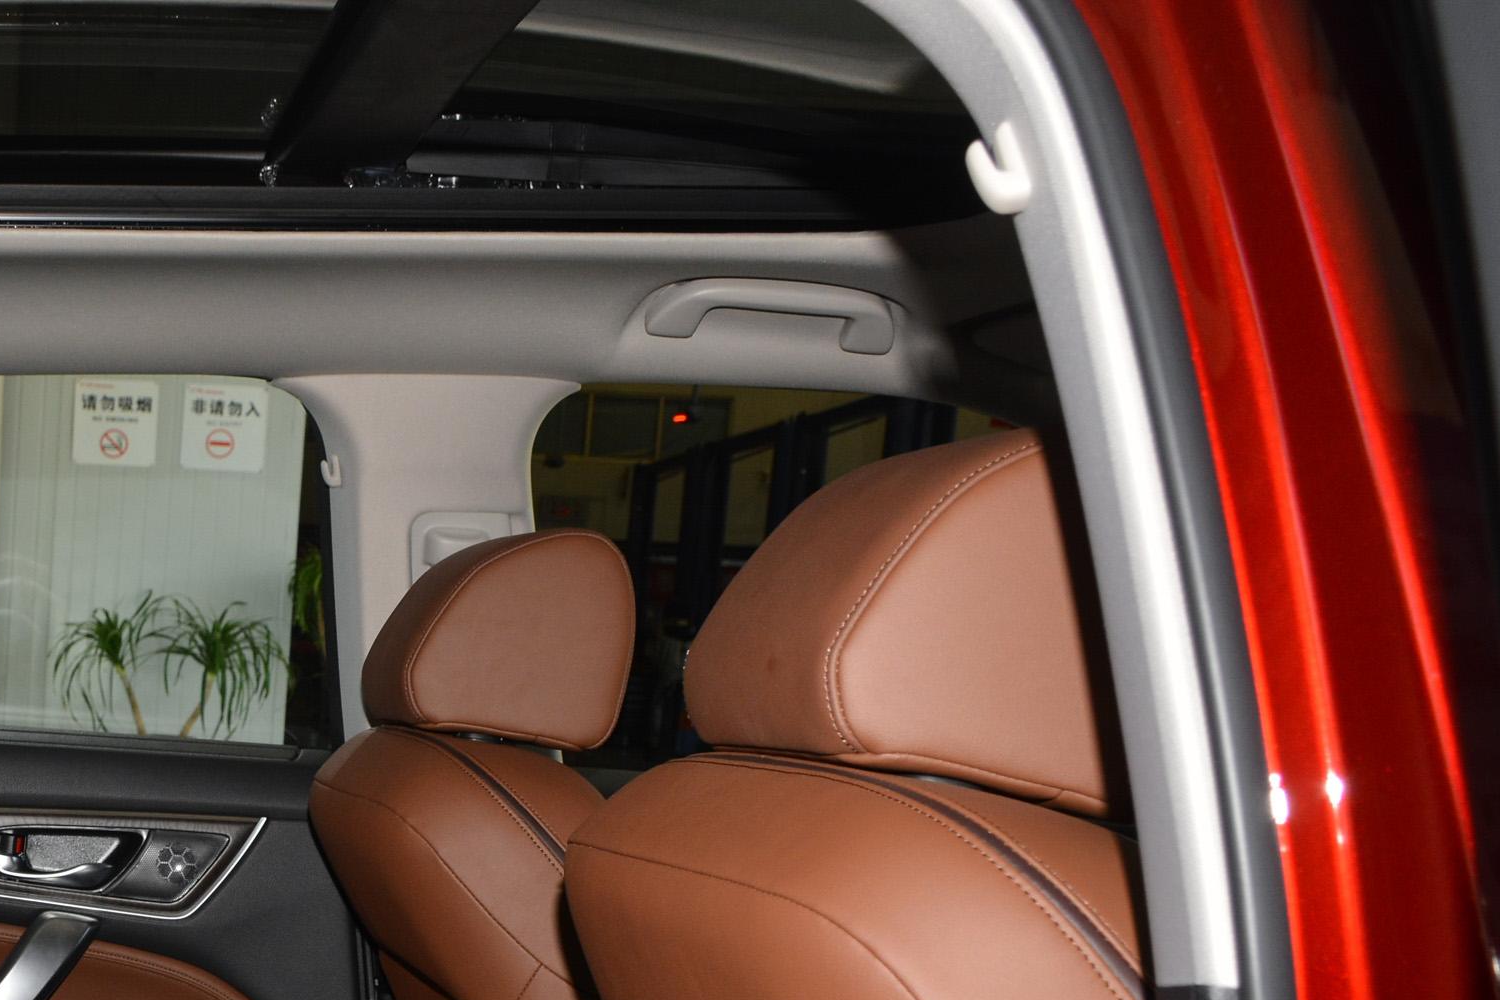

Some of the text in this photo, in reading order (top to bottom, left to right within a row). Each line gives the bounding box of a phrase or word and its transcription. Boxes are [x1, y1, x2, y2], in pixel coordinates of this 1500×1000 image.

[82, 394, 153, 413] 请勿吸烟
[192, 398, 260, 417] 非请勿入
